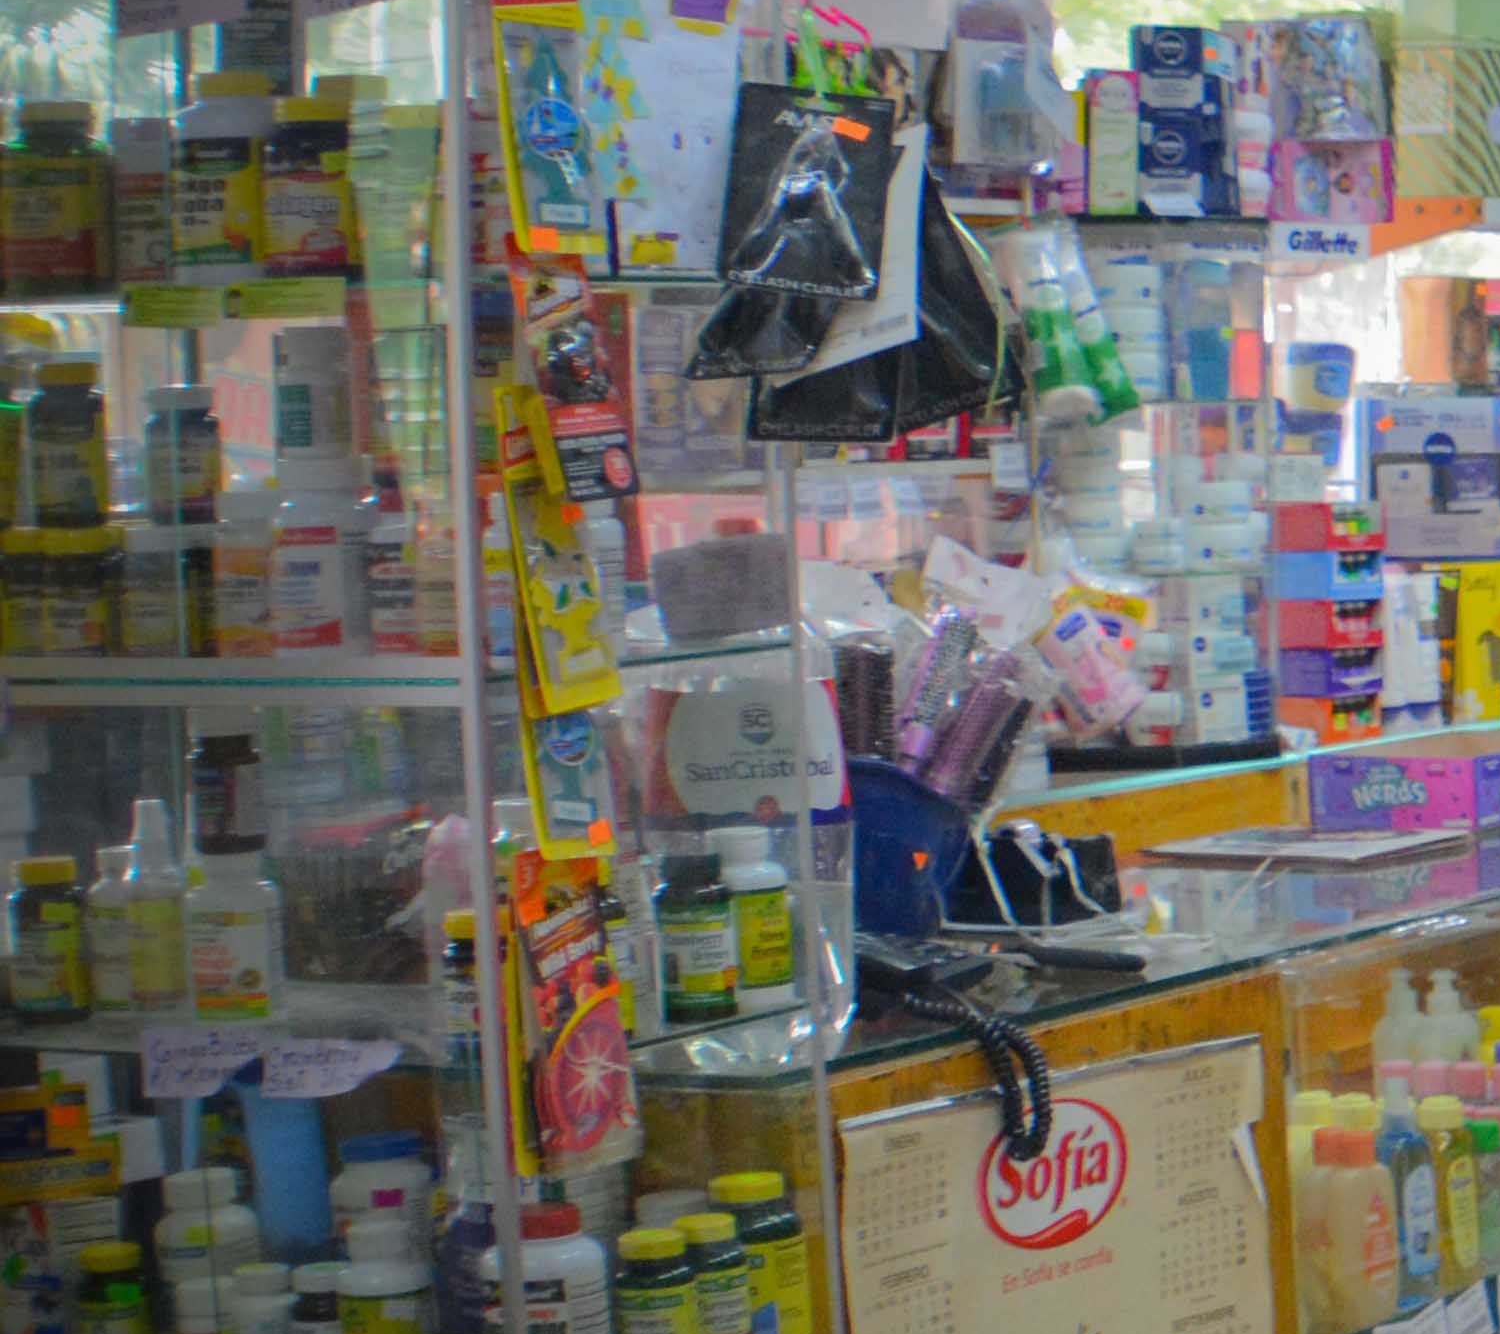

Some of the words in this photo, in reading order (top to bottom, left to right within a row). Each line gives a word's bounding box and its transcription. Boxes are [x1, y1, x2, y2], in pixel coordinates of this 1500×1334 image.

[1288, 230, 1358, 254] Gillette
[684, 754, 835, 784] SanCristbal
[996, 1124, 1112, 1214] Sofía
